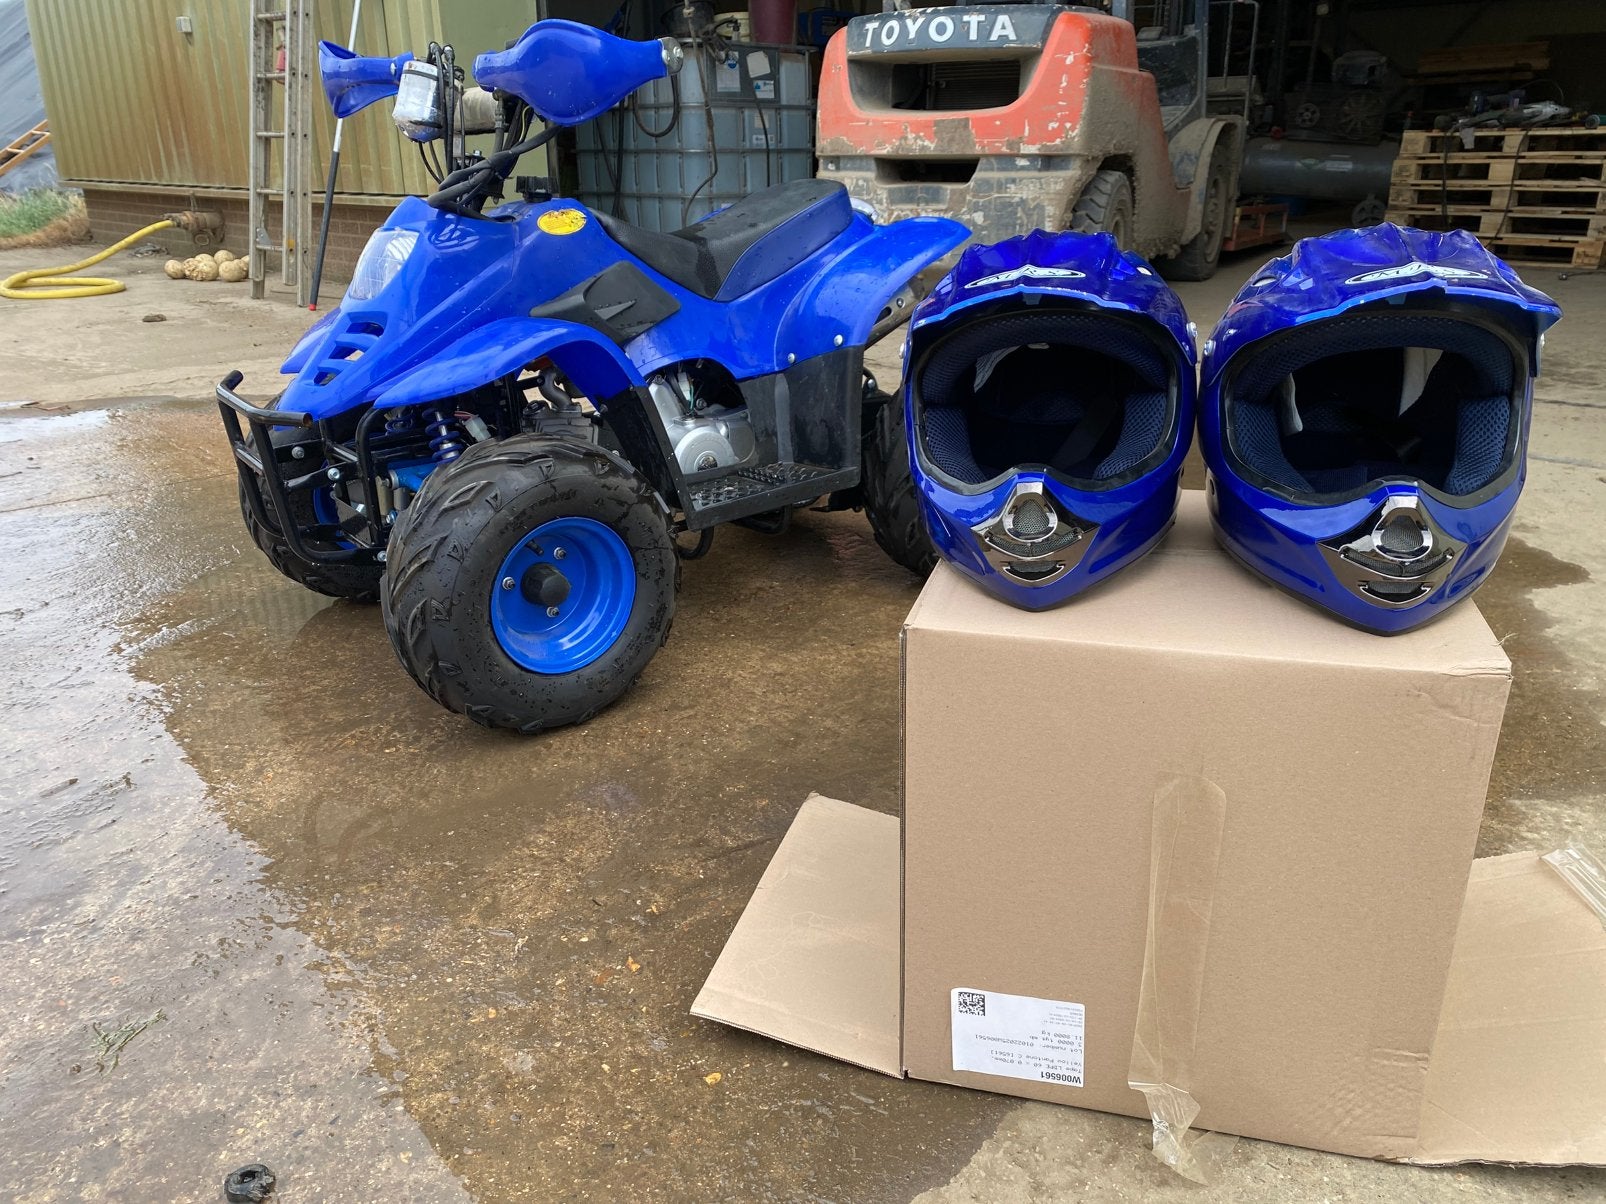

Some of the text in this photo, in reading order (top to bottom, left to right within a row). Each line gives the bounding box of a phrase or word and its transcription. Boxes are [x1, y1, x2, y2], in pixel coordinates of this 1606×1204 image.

[864, 14, 1017, 47] TOYOTA
[1026, 1055, 1054, 1063] Pantone
[1041, 1071, 1081, 1084] W006561
